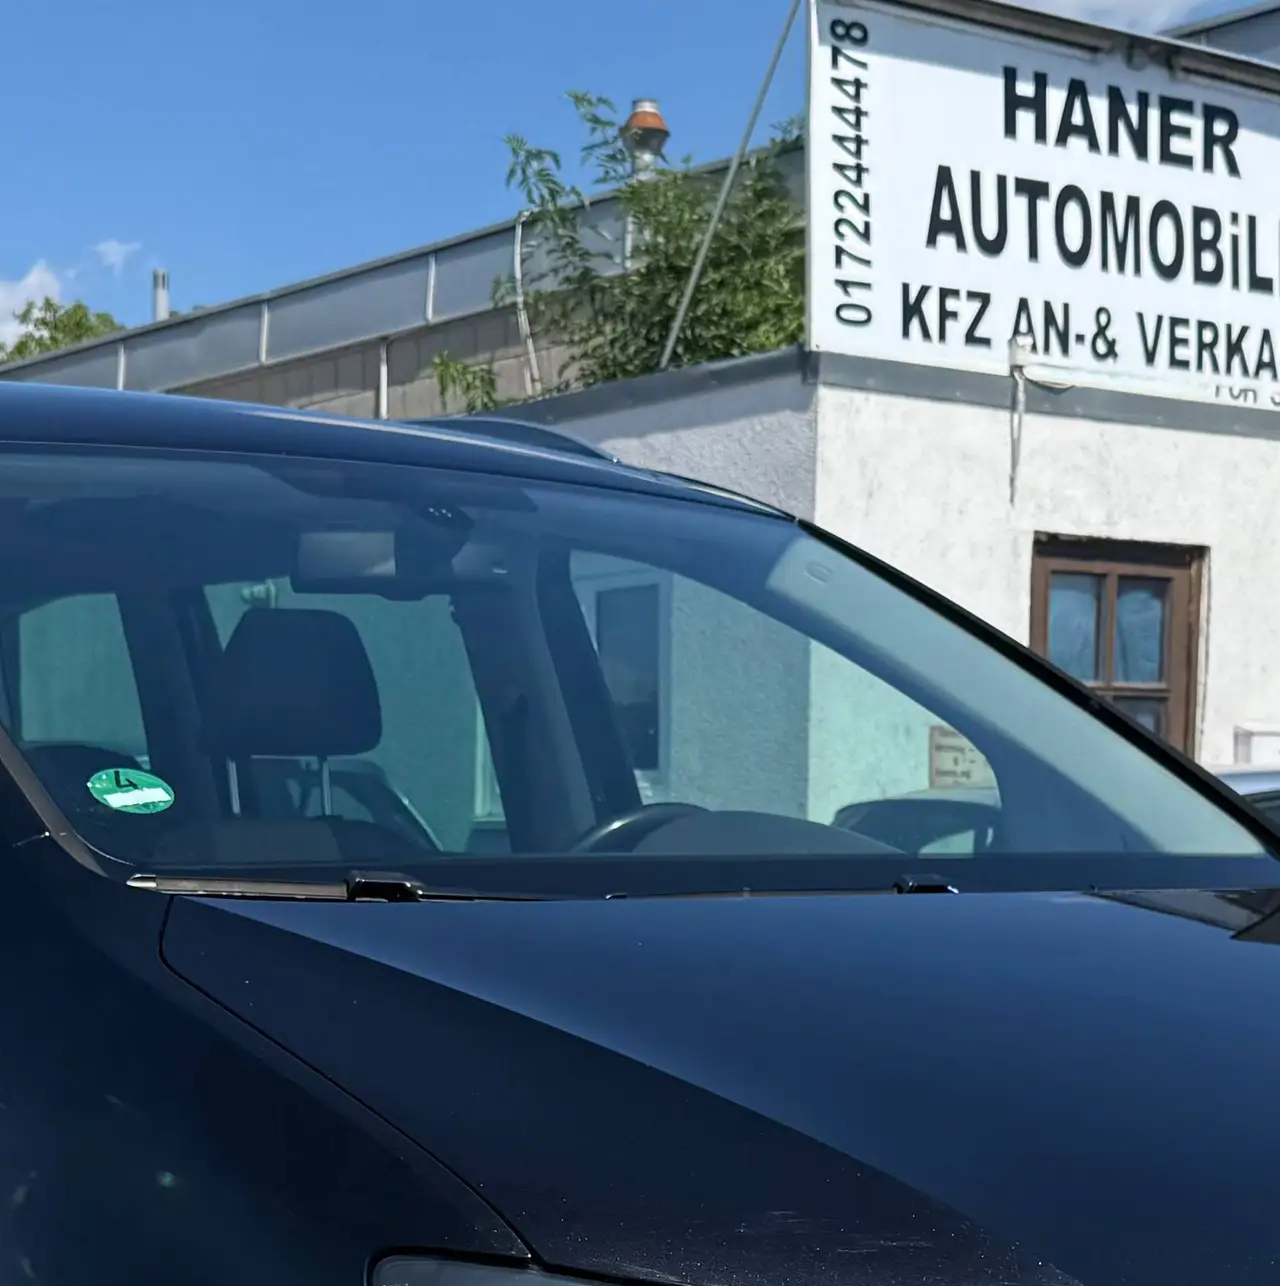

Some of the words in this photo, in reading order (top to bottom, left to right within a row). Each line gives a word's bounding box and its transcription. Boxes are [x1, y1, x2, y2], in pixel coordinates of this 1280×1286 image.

[829, 18, 873, 328] 01722444478
[1002, 65, 1242, 179] HANER
[901, 282, 992, 350] KFZ
